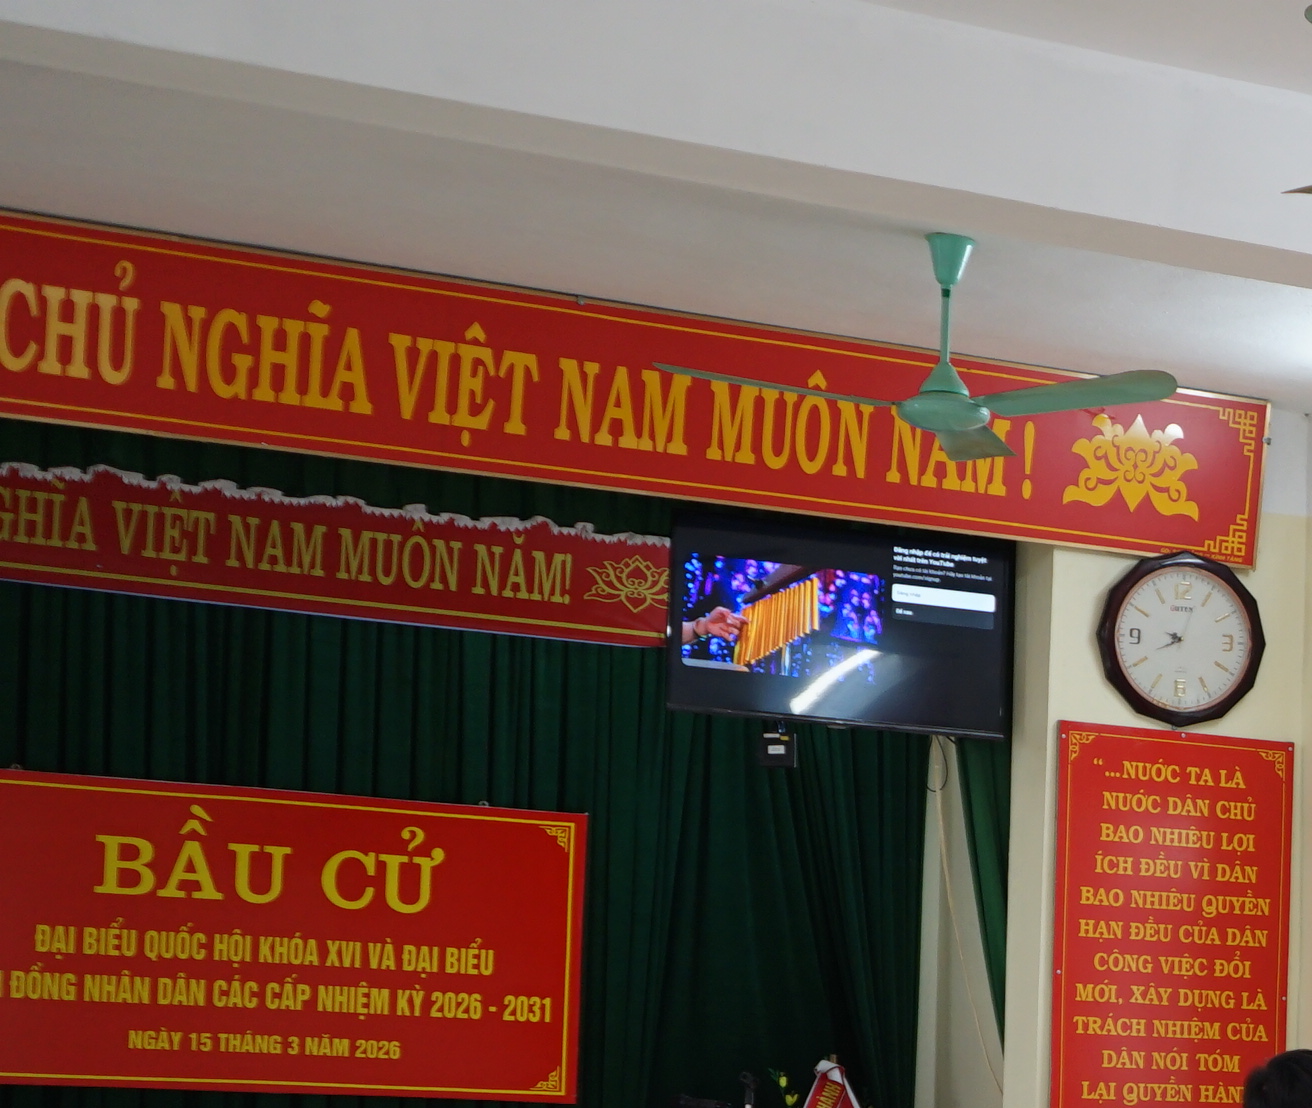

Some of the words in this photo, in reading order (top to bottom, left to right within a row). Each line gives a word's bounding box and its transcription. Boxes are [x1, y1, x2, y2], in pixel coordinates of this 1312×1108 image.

[0, 260, 138, 386] CHỦ
[156, 300, 373, 415] NGHĨA
[388, 322, 539, 447] VIỆT
[553, 358, 692, 456] NAM
[706, 369, 875, 478] MUÔN
[112, 491, 217, 576] VIỆT
[226, 515, 327, 578] NAM
[336, 518, 463, 592] MUÔN
[1186, 767, 1214, 786] TA
[1219, 766, 1246, 789] LÀ
[1103, 790, 1161, 811] NƯỚC
[1167, 795, 1210, 817] DÂN
[1216, 797, 1256, 821] CHỦ
[1100, 823, 1143, 844] BAO
[1150, 826, 1215, 849] NHIÊU
[1221, 833, 1255, 856] LỢI
[93, 804, 293, 904] BẦU
[321, 826, 445, 914] CỬ
[1094, 851, 1133, 875] ÍCH
[1140, 851, 1182, 878] ĐỀU
[1189, 858, 1210, 879] VÌ
[1216, 861, 1258, 884] DÂN
[1080, 886, 1124, 907] BAO
[1130, 888, 1195, 912] NHIÊU
[1202, 890, 1271, 918] QUYỀN
[1079, 919, 1123, 942] HẠN
[1129, 916, 1172, 942] ĐỀU
[1179, 920, 1221, 945] CỦA
[1226, 927, 1268, 947] DÂN
[35, 924, 75, 961] ĐẠI
[83, 918, 137, 957] BIỂU
[143, 923, 207, 961] QUỐC
[213, 929, 252, 969] HỘI
[258, 931, 318, 967] KHÓA
[325, 940, 361, 970] XVI
[368, 936, 396, 971] VÀ
[402, 944, 439, 980] ĐẠI
[444, 937, 495, 976] BIỂU
[1094, 950, 1153, 973] CÔNG
[1158, 954, 1208, 979] VIỆC
[1214, 951, 1251, 978] ĐỔI
[9, 962, 76, 1001] ĐỒNG
[83, 971, 150, 1005] NHÂN
[158, 971, 207, 1007] DÂN
[213, 973, 259, 1010] CÁC
[265, 971, 311, 1012] CẤP
[317, 983, 390, 1021] NHIỆM
[396, 984, 425, 1016] KỲ
[430, 993, 482, 1020] 2026
[503, 996, 552, 1023] 2031
[1075, 980, 1123, 1005] MỚI,
[1129, 983, 1172, 1006] XÂY
[1178, 989, 1235, 1012] DỰNG
[1241, 989, 1267, 1011] LÀ
[128, 1026, 181, 1052] NGÀY
[187, 1032, 212, 1053] 15
[218, 1029, 281, 1055] THÁNG
[287, 1036, 299, 1055] 3
[305, 1031, 350, 1058] NĂM
[355, 1039, 400, 1060] 2026
[1073, 1013, 1146, 1037] TRÁCH
[1152, 1017, 1221, 1043] NHIỆM
[1227, 1017, 1268, 1042] CỦA
[1102, 1047, 1145, 1069] DÂN
[1152, 1048, 1188, 1071] NÓI
[1196, 1049, 1241, 1073] TÓM
